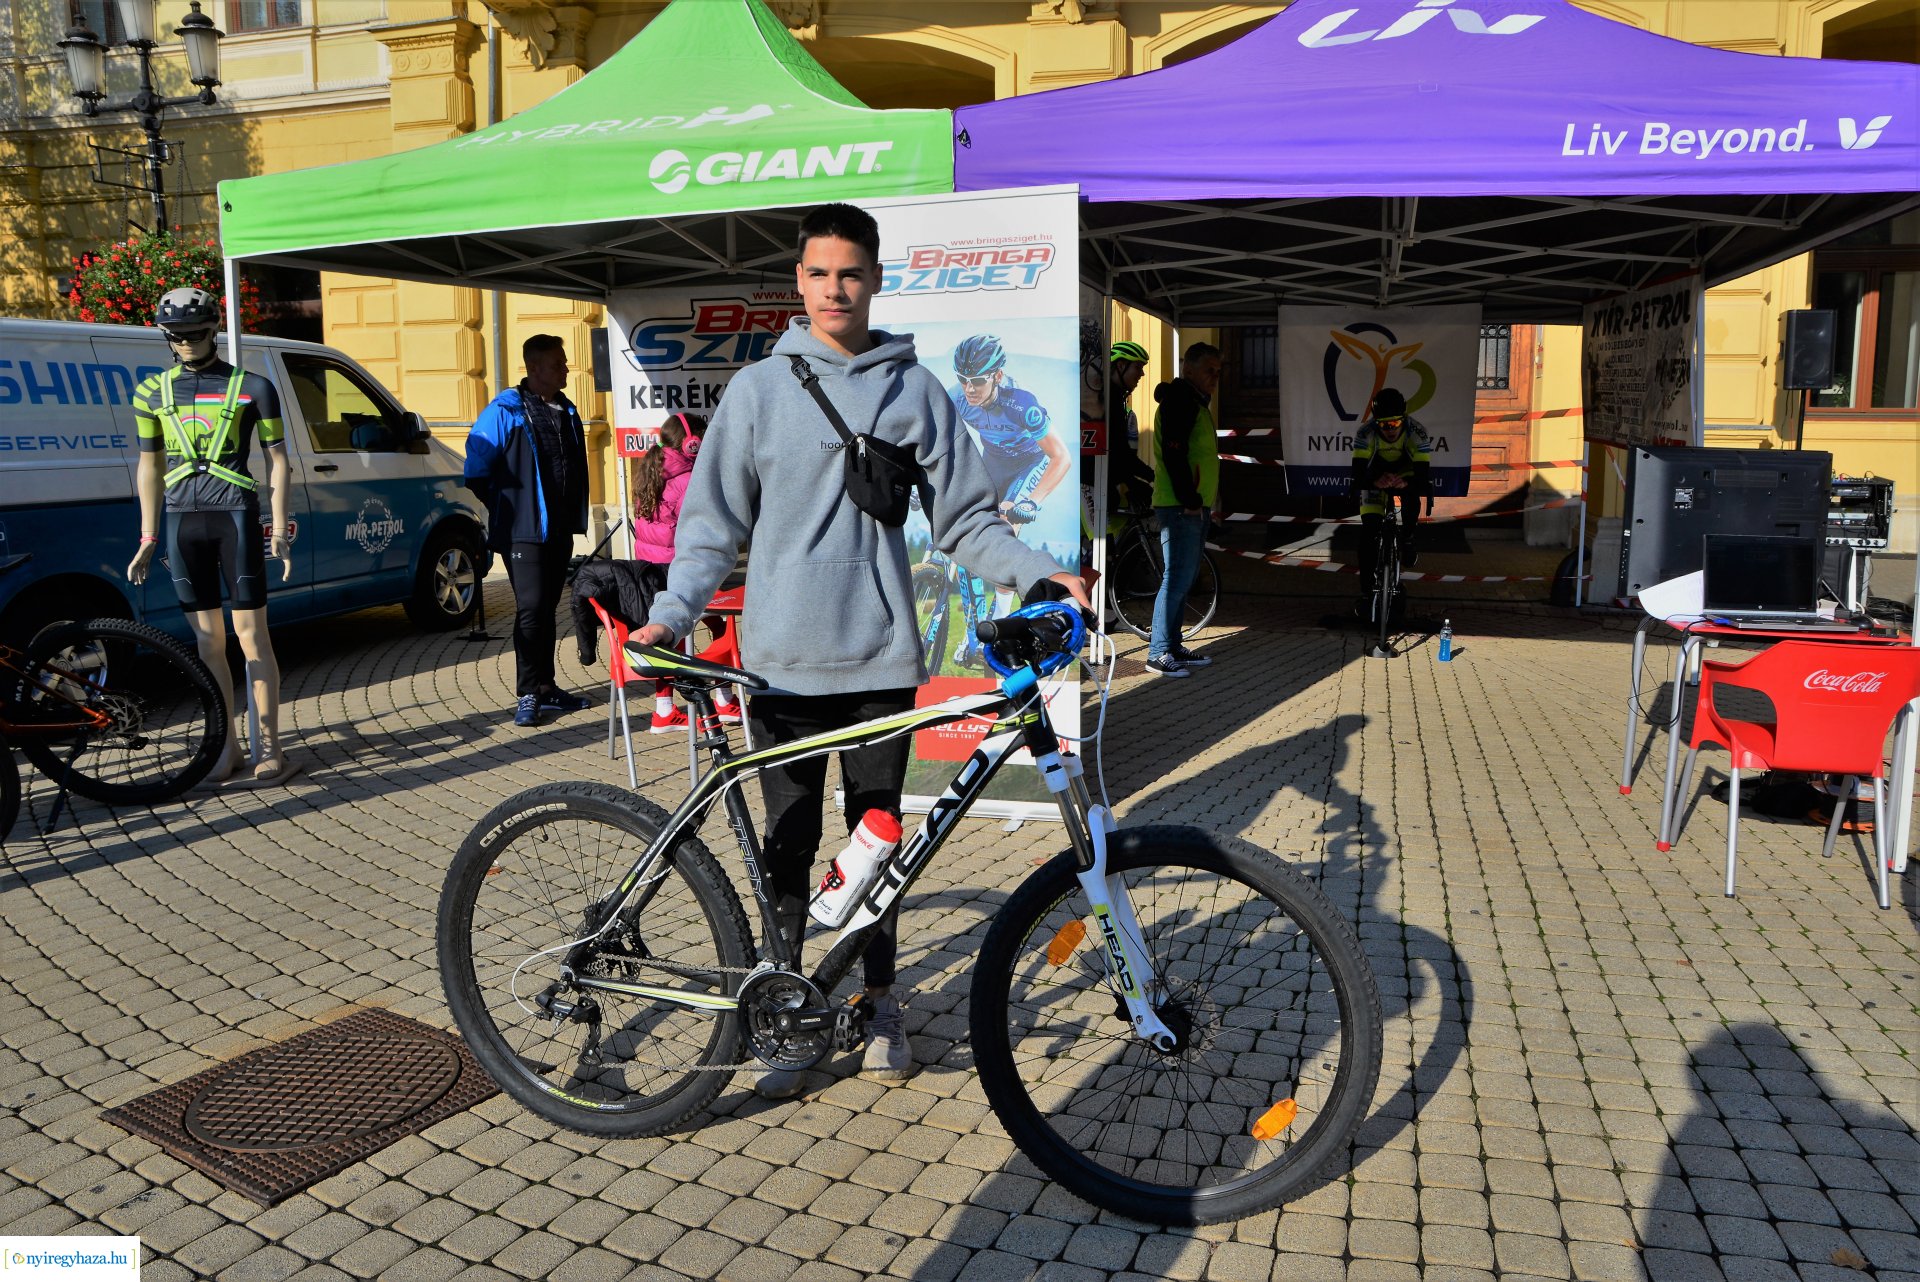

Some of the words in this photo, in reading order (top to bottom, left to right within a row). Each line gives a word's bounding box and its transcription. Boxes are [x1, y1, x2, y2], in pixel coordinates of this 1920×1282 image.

[456, 113, 690, 150] HYBRID
[1562, 123, 1628, 156] Liv
[1639, 119, 1815, 160] Beyond.
[695, 141, 893, 185] GIANT
[950, 233, 1053, 246] www.bringasziget.hu
[881, 263, 1046, 292] SZIGET
[633, 324, 782, 364] SZIG
[0, 360, 166, 405] SHIM
[630, 377, 725, 410] KERÉK
[0, 435, 128, 450] SERVICE
[723, 671, 749, 682] HEAD
[1804, 669, 1889, 693] Coca-Cola
[479, 825, 504, 849] CST
[503, 802, 568, 829] GRIPPER
[864, 748, 990, 916] HEAD
[1098, 914, 1134, 992] HEAD
[547, 1087, 601, 1109] DRAGON
